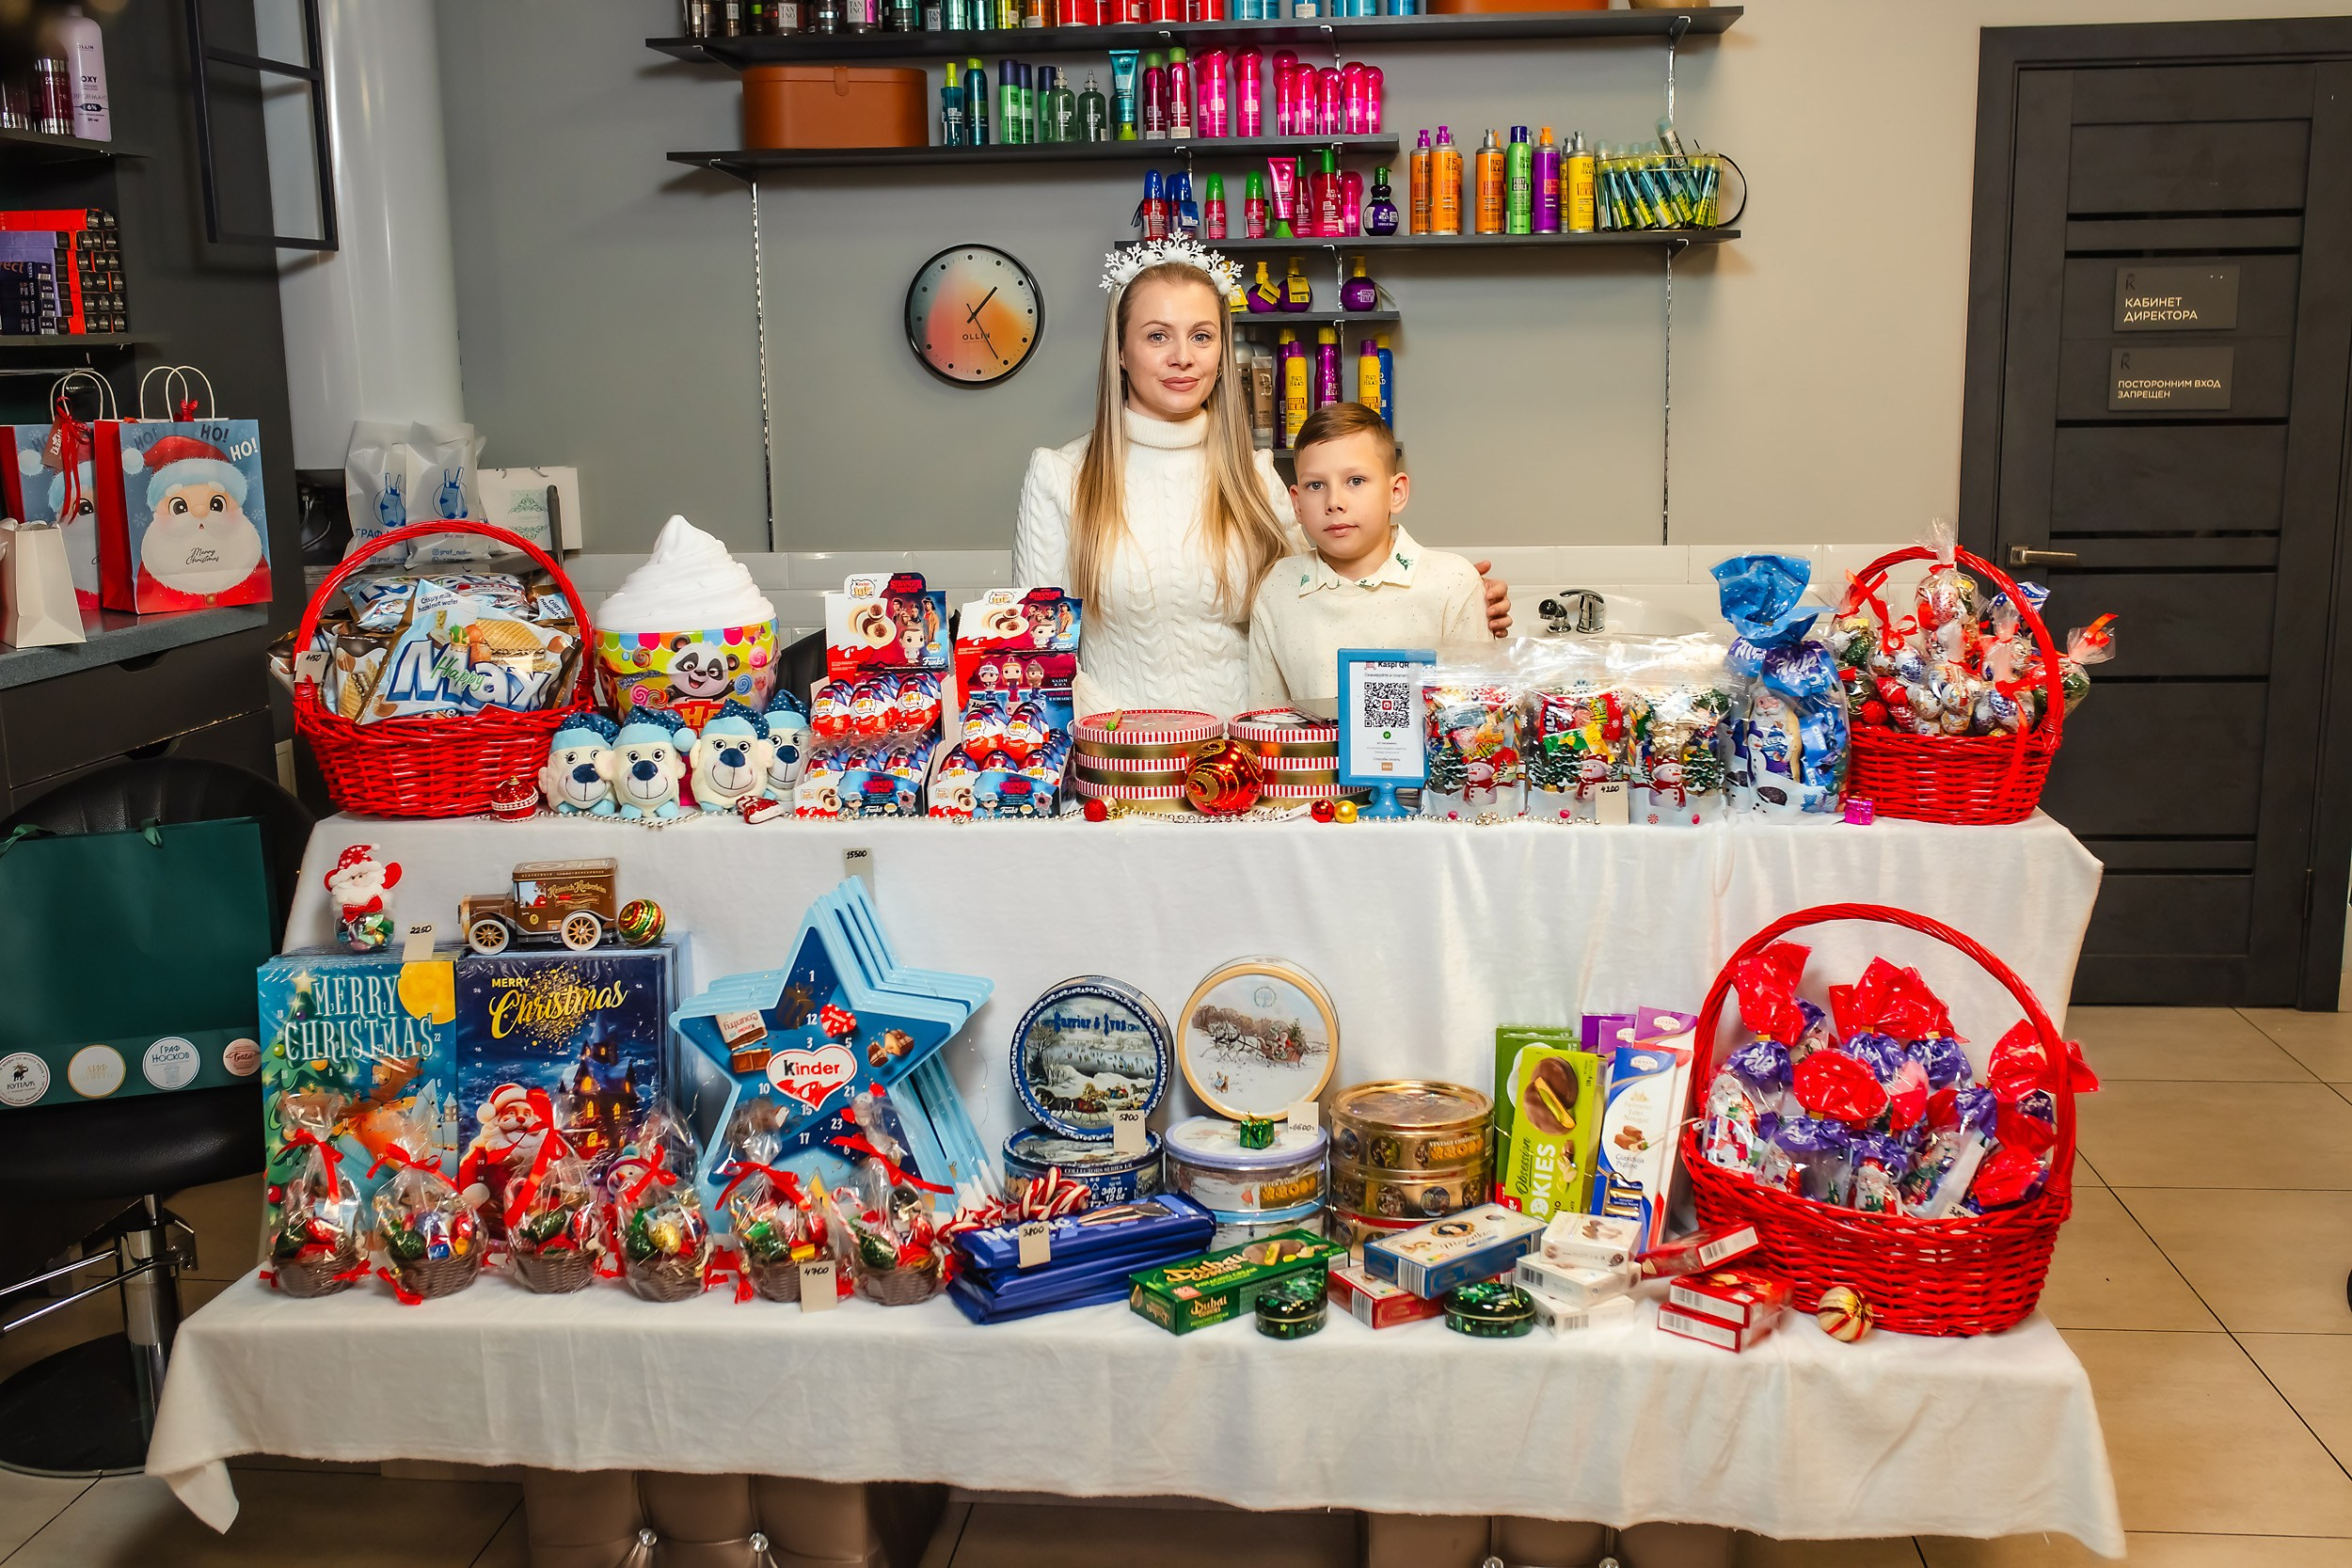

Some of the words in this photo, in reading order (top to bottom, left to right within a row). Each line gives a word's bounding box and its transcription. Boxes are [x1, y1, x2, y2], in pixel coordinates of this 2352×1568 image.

[81, 75, 98, 84] OXY
[2125, 297, 2183, 308] КАБИНЕТ
[2123, 310, 2198, 323] ДИРЕКТОРА
[2118, 379, 2192, 388] ПОСТОРОННИМ
[2194, 379, 2221, 388] ВХОД
[2117, 390, 2170, 400] ЗАПРЕЩЕН
[200, 423, 229, 443] HO!
[230, 437, 259, 462] HO!
[190, 547, 216, 559] Merry
[185, 554, 220, 566] Christmas
[421, 594, 438, 604] Crispy
[418, 600, 441, 612] hazelnut
[548, 598, 563, 614] Crispy
[922, 657, 945, 666] Funko
[386, 641, 552, 712] Max
[431, 655, 486, 692] Happy
[1600, 784, 1620, 793] 4200
[847, 849, 867, 860] 15500
[547, 884, 575, 898] Heinrich
[409, 925, 432, 934] 2250
[809, 970, 815, 982] 1
[491, 977, 531, 988] MERRY
[312, 974, 401, 1020] MERRY
[488, 979, 628, 1039] Christmas
[723, 1012, 758, 1030] Country
[806, 1013, 818, 1025] 12
[284, 1012, 434, 1064] CHRISTMAS
[805, 1037, 813, 1049] 3
[845, 1037, 852, 1048] 5
[159, 1045, 181, 1054] ГРАФ
[151, 1052, 190, 1063] НОСКОВ
[783, 1059, 840, 1075] kinder
[7, 1081, 36, 1090] КУПАЖ
[758, 1083, 771, 1095] 10
[843, 1085, 855, 1097] 21
[801, 1103, 813, 1116] 15
[831, 1117, 843, 1130] 23
[799, 1132, 810, 1144] 17
[843, 1144, 850, 1155] 6
[1515, 1135, 1532, 1196] Obsession
[1101, 1187, 1117, 1196] 340
[1163, 1253, 1251, 1282] Dubai
[1191, 1294, 1228, 1316] Dubai
